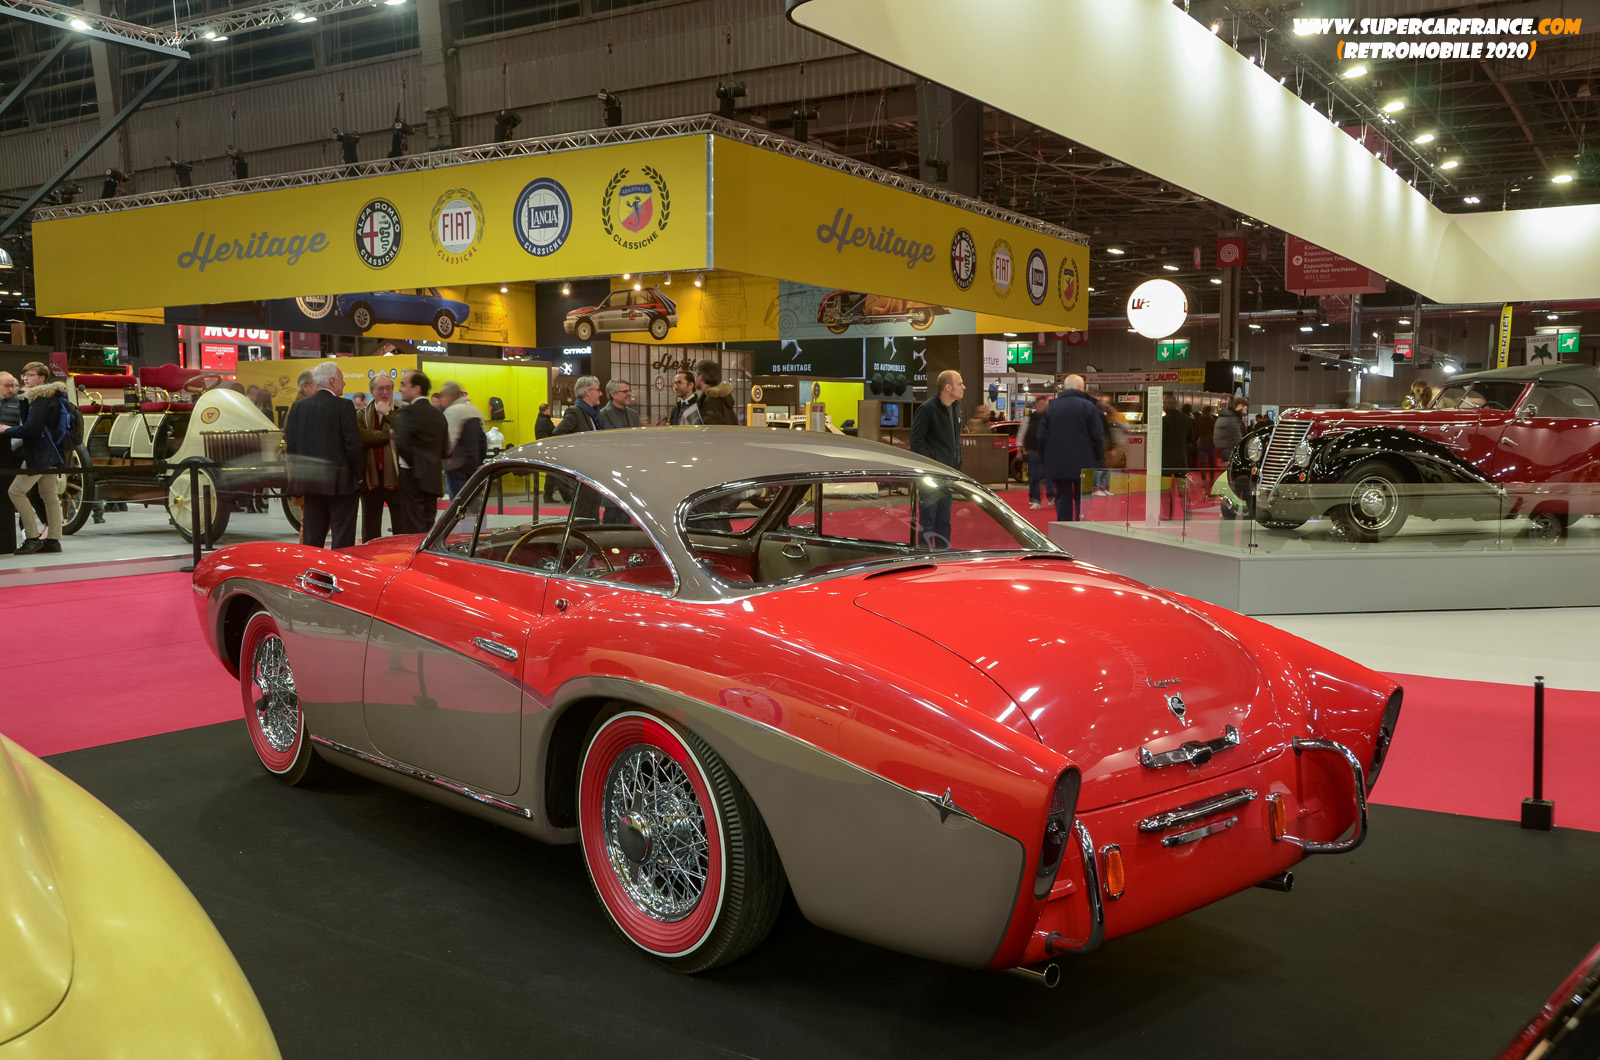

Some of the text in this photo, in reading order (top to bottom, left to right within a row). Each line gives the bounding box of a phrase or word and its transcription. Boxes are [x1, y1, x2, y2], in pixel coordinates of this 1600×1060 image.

[356, 202, 401, 236] ALFA ROMEO
[442, 211, 472, 242] FIAT
[530, 207, 558, 229] LANCIA
[524, 239, 563, 255] CLASSICHE
[613, 231, 659, 250] CLASSICHE
[816, 207, 936, 269] Heritage
[177, 231, 330, 272] Heritage
[360, 244, 398, 266] CLASSICHE
[437, 246, 477, 264] CLASSICHE
[953, 269, 974, 288] CLASSICHE
[995, 256, 1009, 282] FIAT
[1527, 336, 1556, 344] LIBRAIRIE
[563, 346, 592, 355] CITROË
[652, 353, 696, 373] Herit
[782, 363, 812, 372] HÉRITAGE
[880, 363, 906, 372] AUTOMOBILES
[1158, 373, 1177, 381] AUTO
